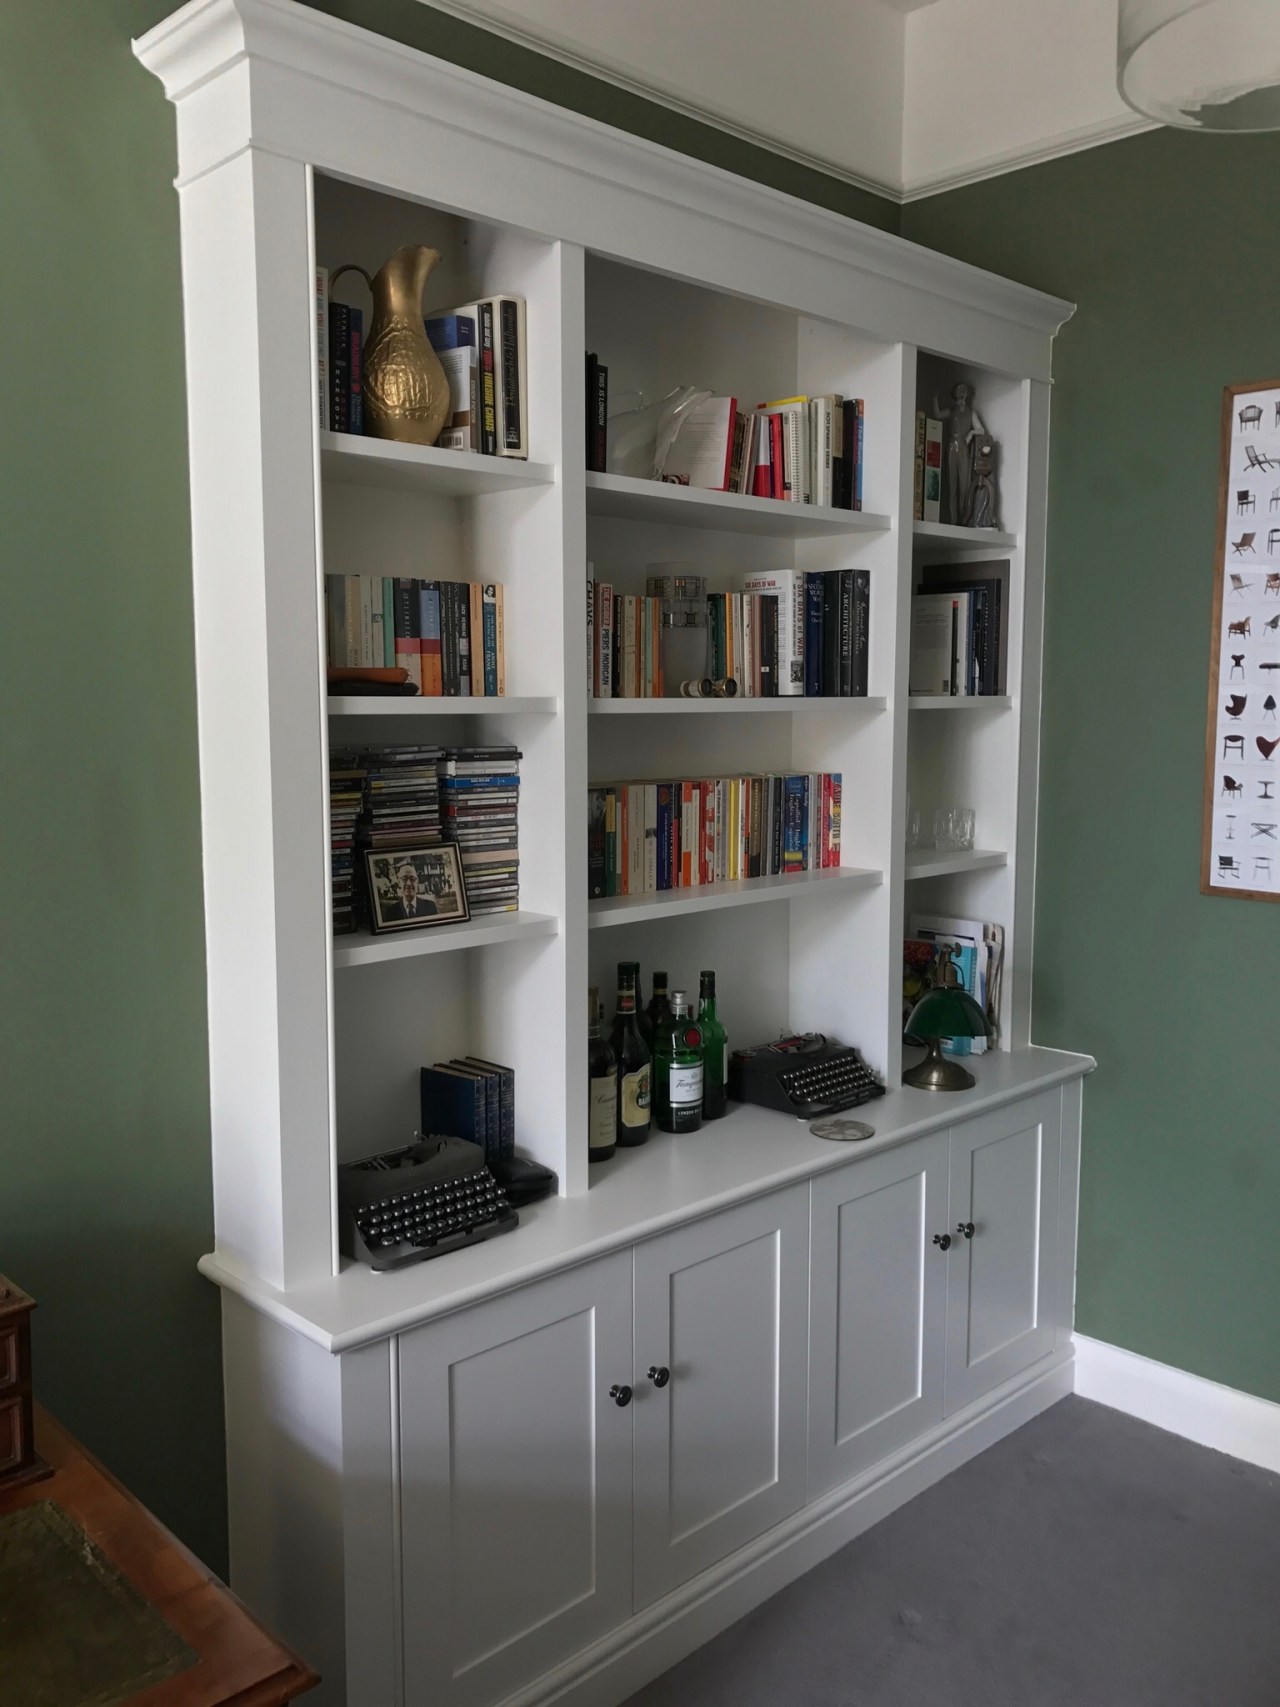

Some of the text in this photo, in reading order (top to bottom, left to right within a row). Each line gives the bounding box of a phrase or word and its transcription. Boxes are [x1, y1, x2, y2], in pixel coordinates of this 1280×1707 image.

[483, 372, 494, 405] FIRESIDE
[485, 407, 495, 432] CHATS
[603, 587, 611, 600] THE
[602, 628, 610, 650] PIERS
[602, 653, 610, 686] MORGAN
[678, 1108, 694, 1116] LONDON
